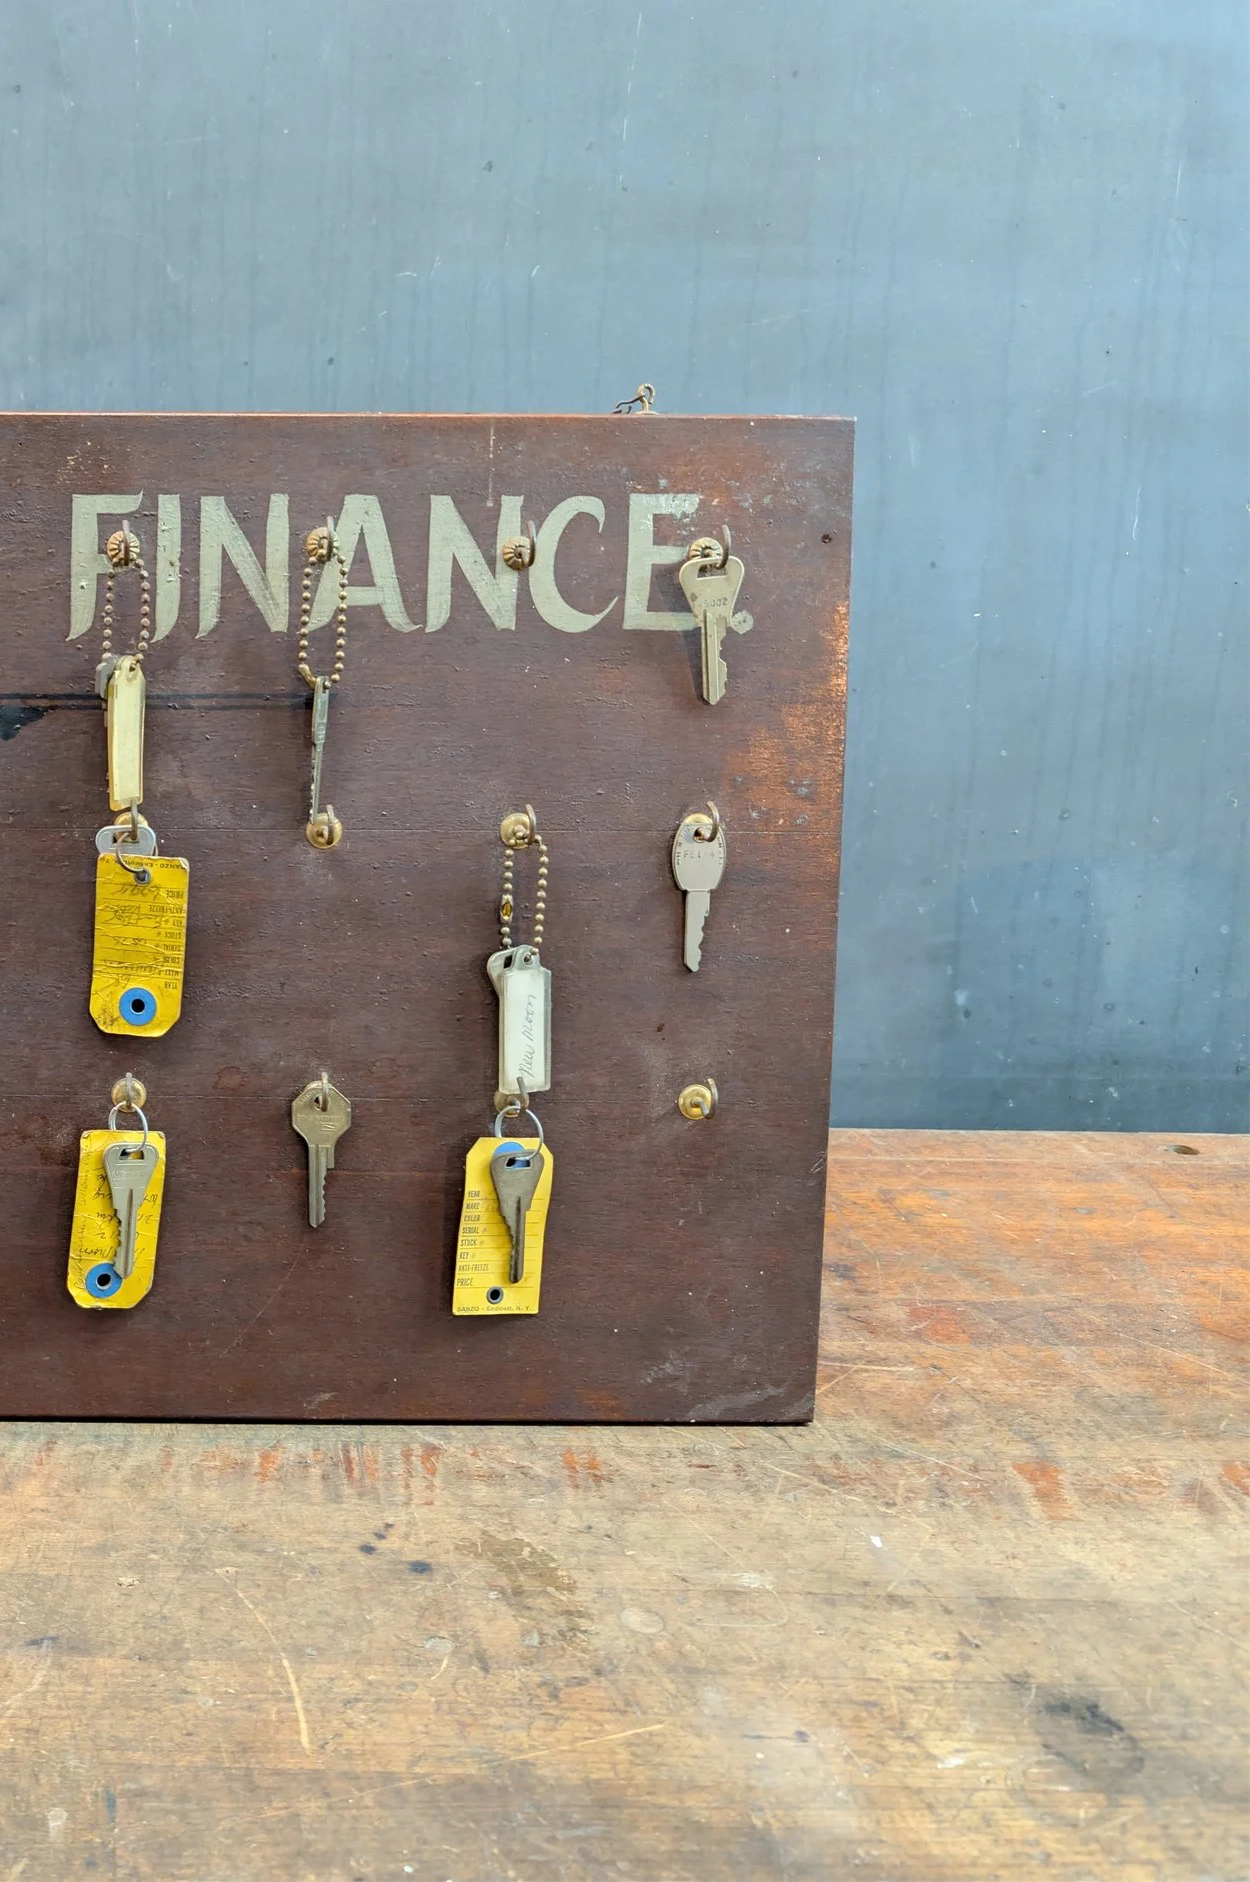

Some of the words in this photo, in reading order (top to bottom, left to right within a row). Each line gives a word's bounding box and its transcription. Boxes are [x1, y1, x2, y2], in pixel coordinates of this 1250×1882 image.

[165, 890, 184, 900] PRICE
[163, 944, 181, 952] SERIAL
[164, 981, 178, 989] YEAR
[468, 1190, 481, 1198] YEAR
[465, 1202, 480, 1210] MAKE
[461, 1226, 480, 1234] SERIAL
[460, 1239, 477, 1247] STOCK
[459, 1251, 470, 1259] KEY
[458, 1263, 490, 1272] ANTI-FREEZE
[456, 1277, 474, 1286] PRICE
